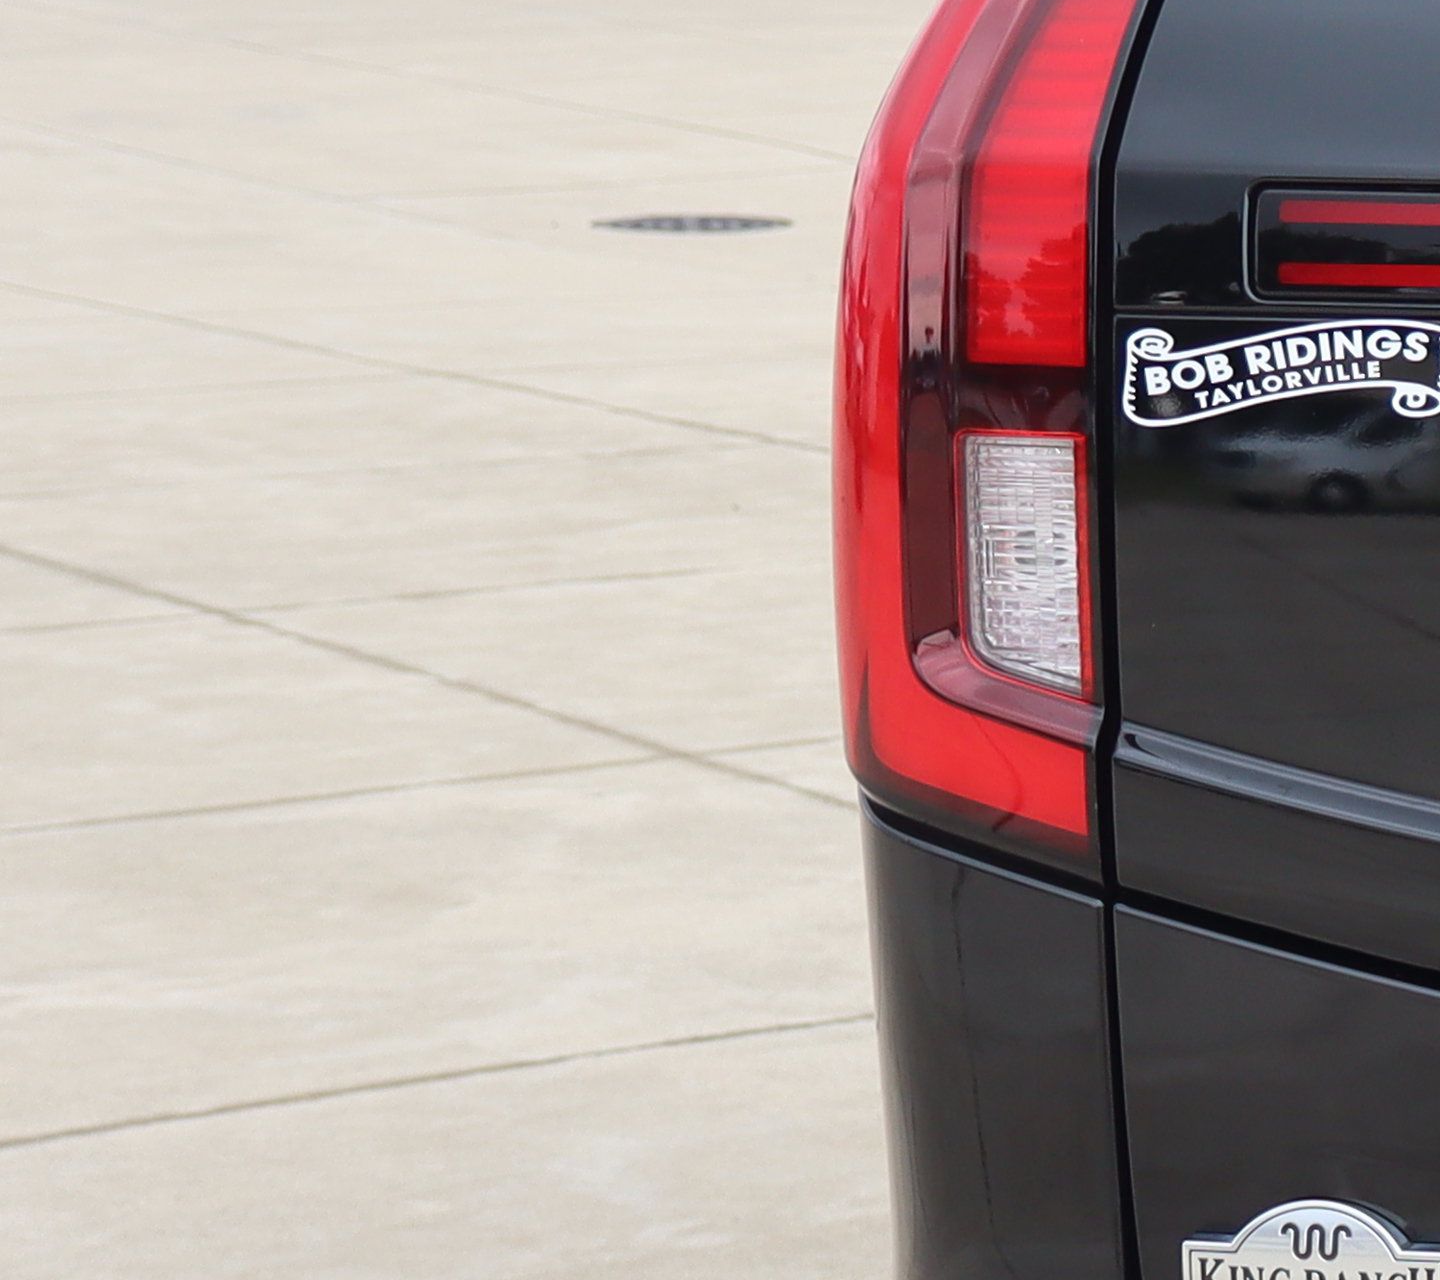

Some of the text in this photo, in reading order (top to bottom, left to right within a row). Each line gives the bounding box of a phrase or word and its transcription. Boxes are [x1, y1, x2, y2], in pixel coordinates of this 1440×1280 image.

[1144, 329, 1429, 396] BOB RIDINGS
[1194, 361, 1381, 409] TAYLORVILLE
